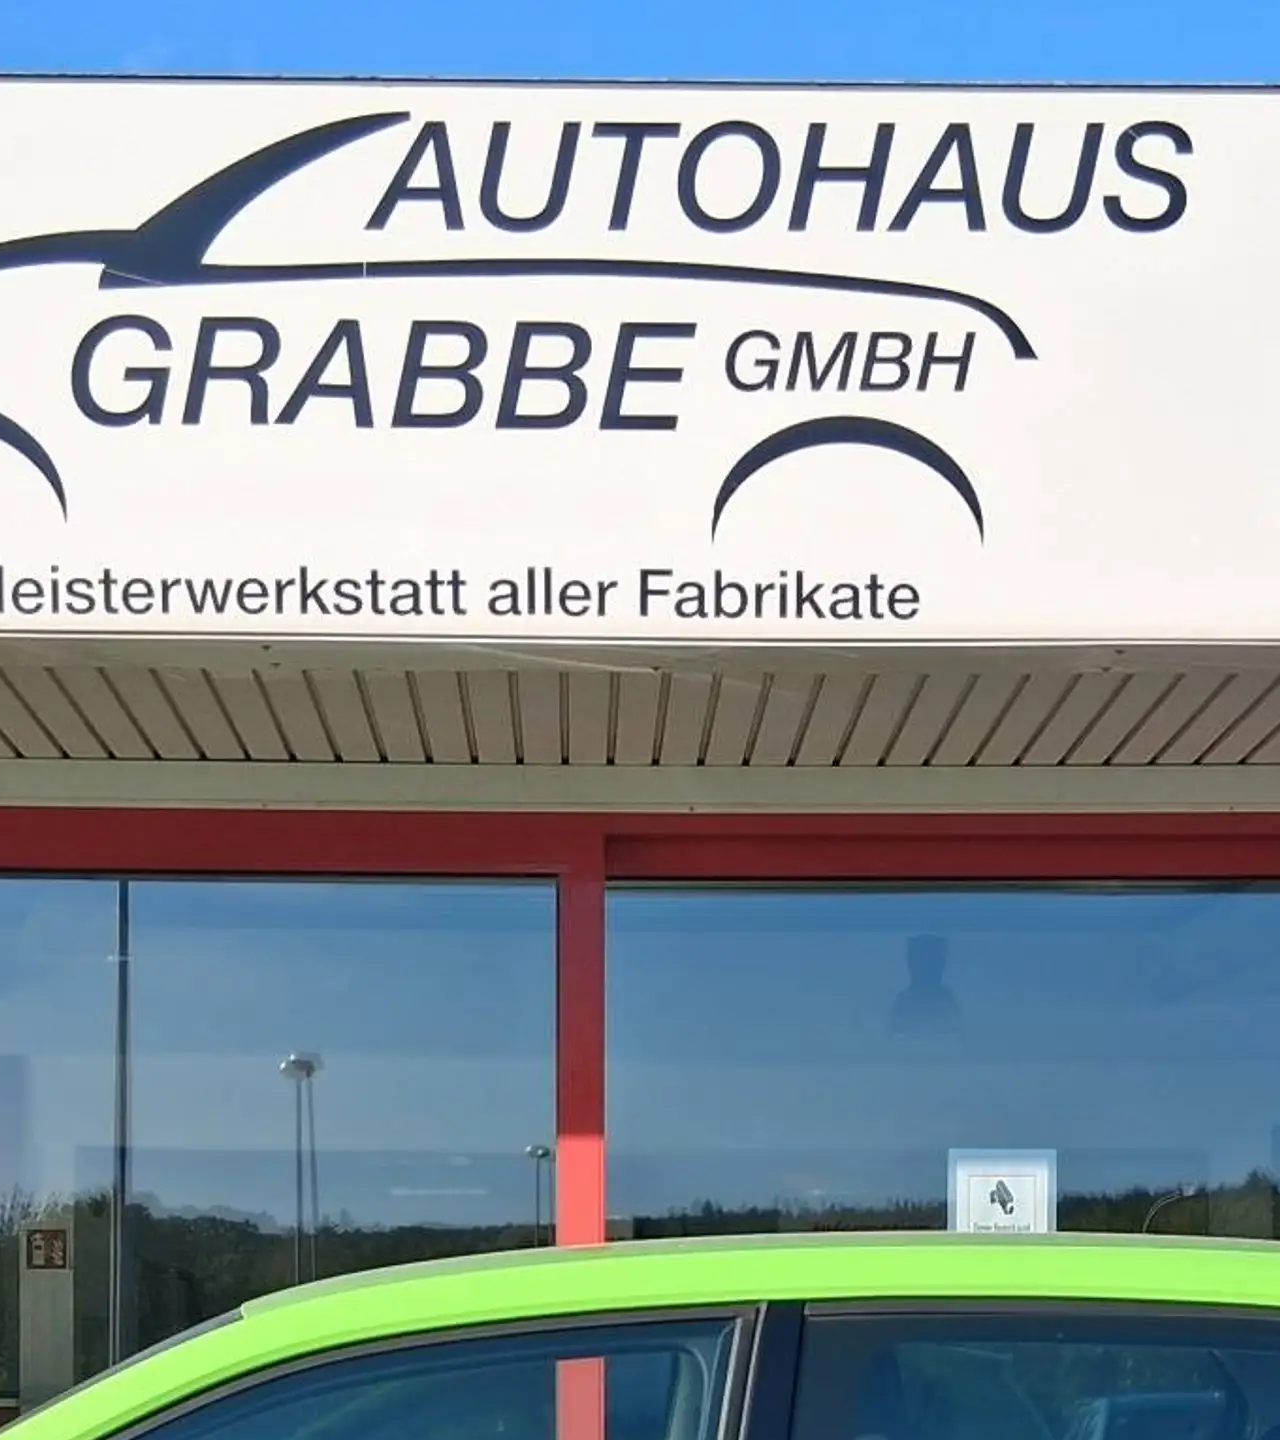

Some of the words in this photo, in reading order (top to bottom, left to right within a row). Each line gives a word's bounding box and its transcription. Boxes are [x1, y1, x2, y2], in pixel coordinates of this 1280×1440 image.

[366, 119, 1194, 235] AUTOHAUS
[70, 313, 698, 432] GRABBE
[724, 329, 977, 393] GMBH
[487, 566, 619, 618] aller
[639, 568, 922, 621] Fabrikate
